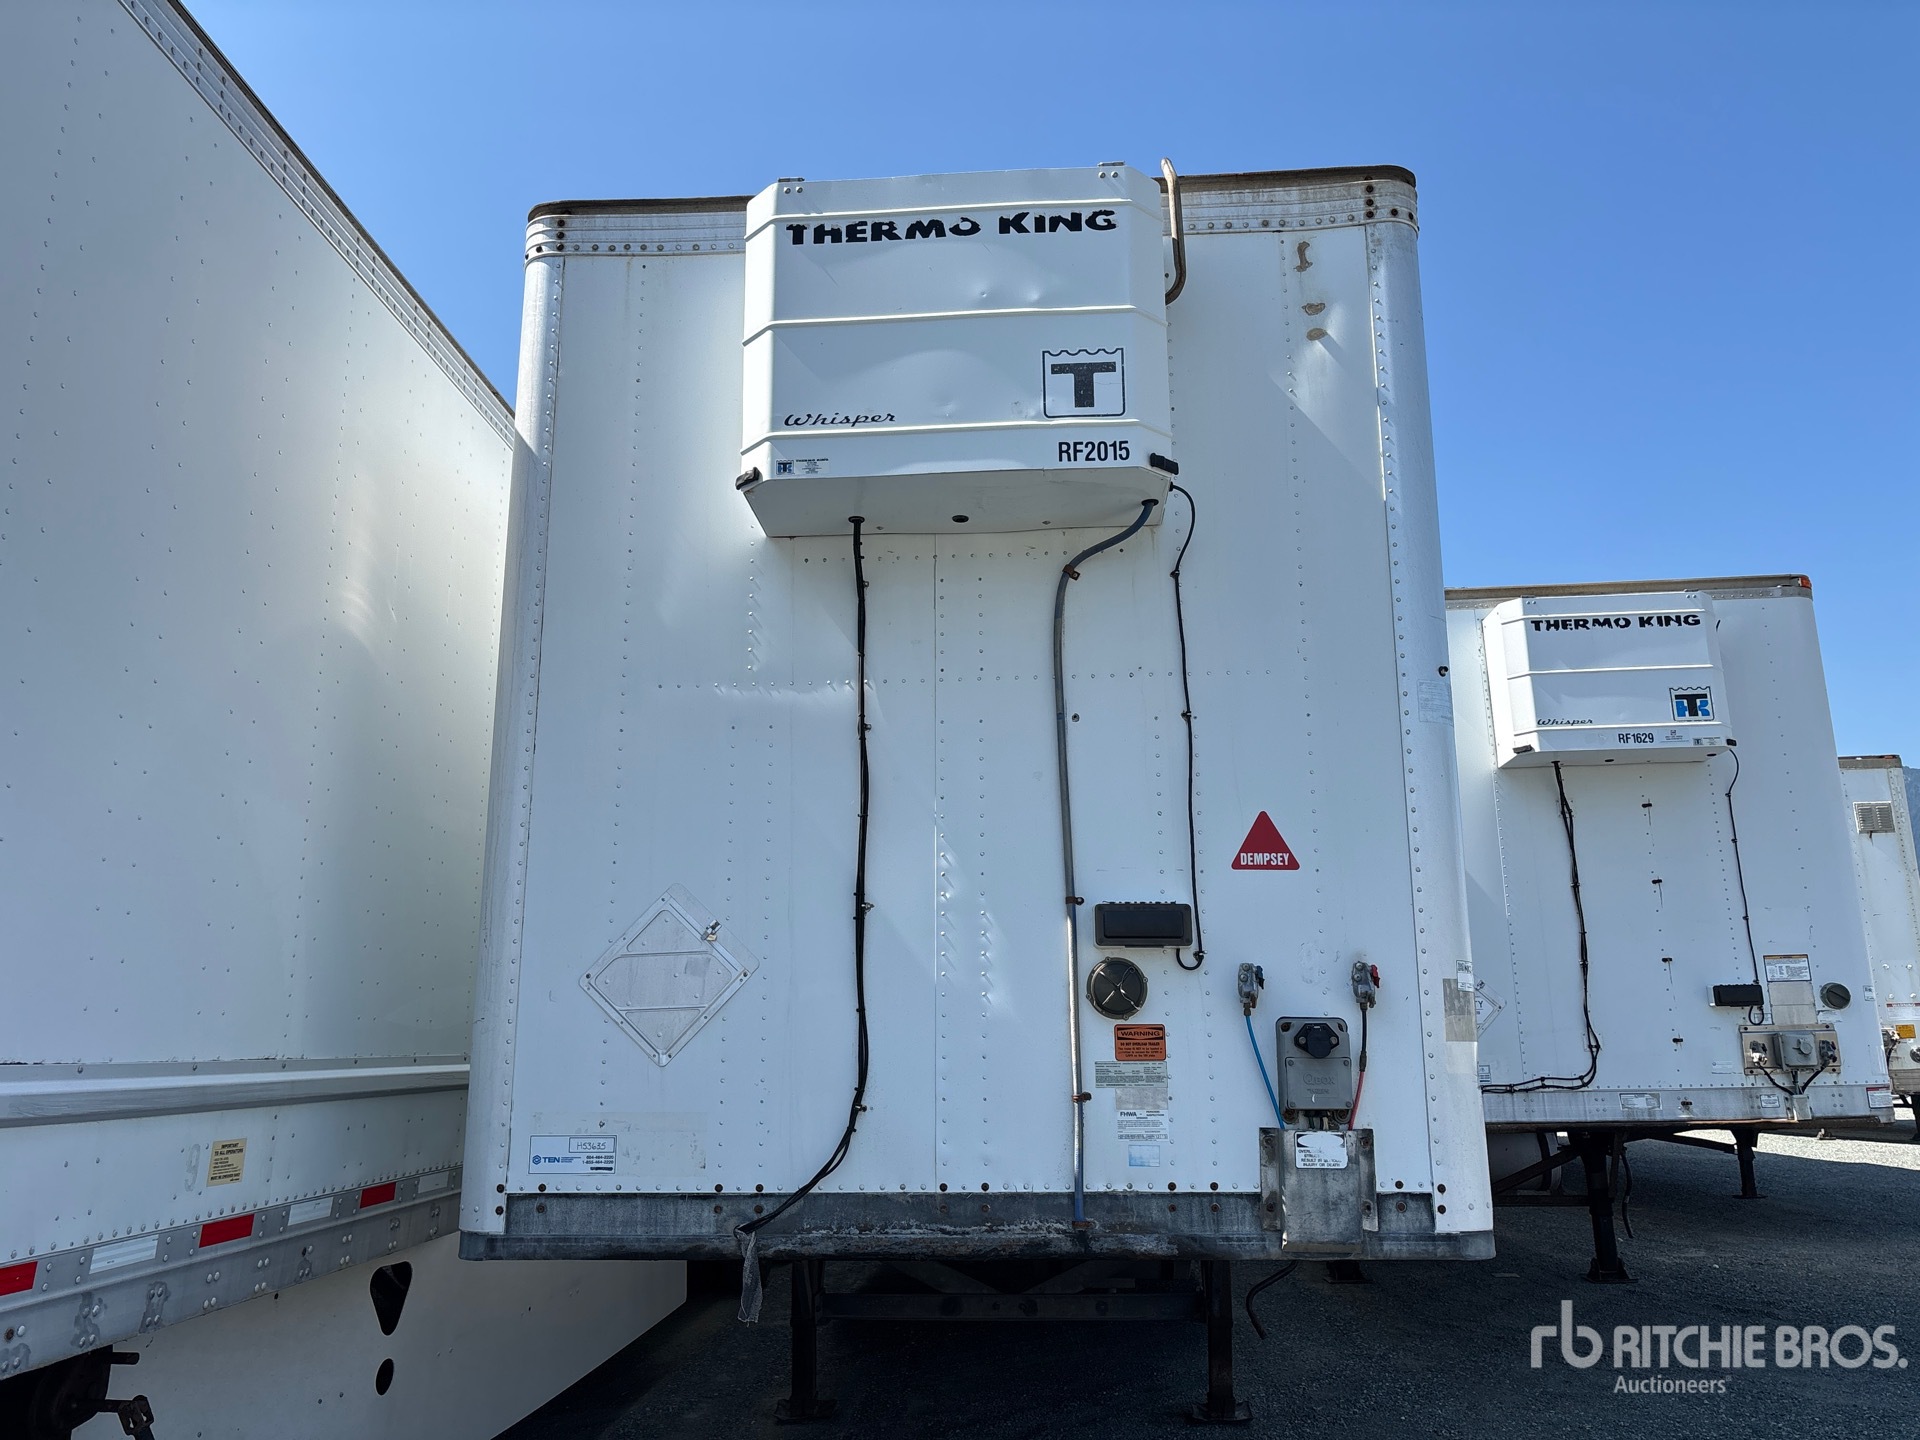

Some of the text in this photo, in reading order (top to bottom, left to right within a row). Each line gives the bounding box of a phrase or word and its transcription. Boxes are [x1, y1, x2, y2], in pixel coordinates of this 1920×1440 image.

[786, 209, 1117, 246] THERMO KING
[783, 412, 896, 428] Whisper
[1058, 440, 1131, 462] RF2015
[1530, 614, 1701, 632] THERMO KING
[1537, 718, 1594, 727] Whisper
[1617, 732, 1655, 744] RF1629
[1240, 852, 1290, 866] DEMPSEY
